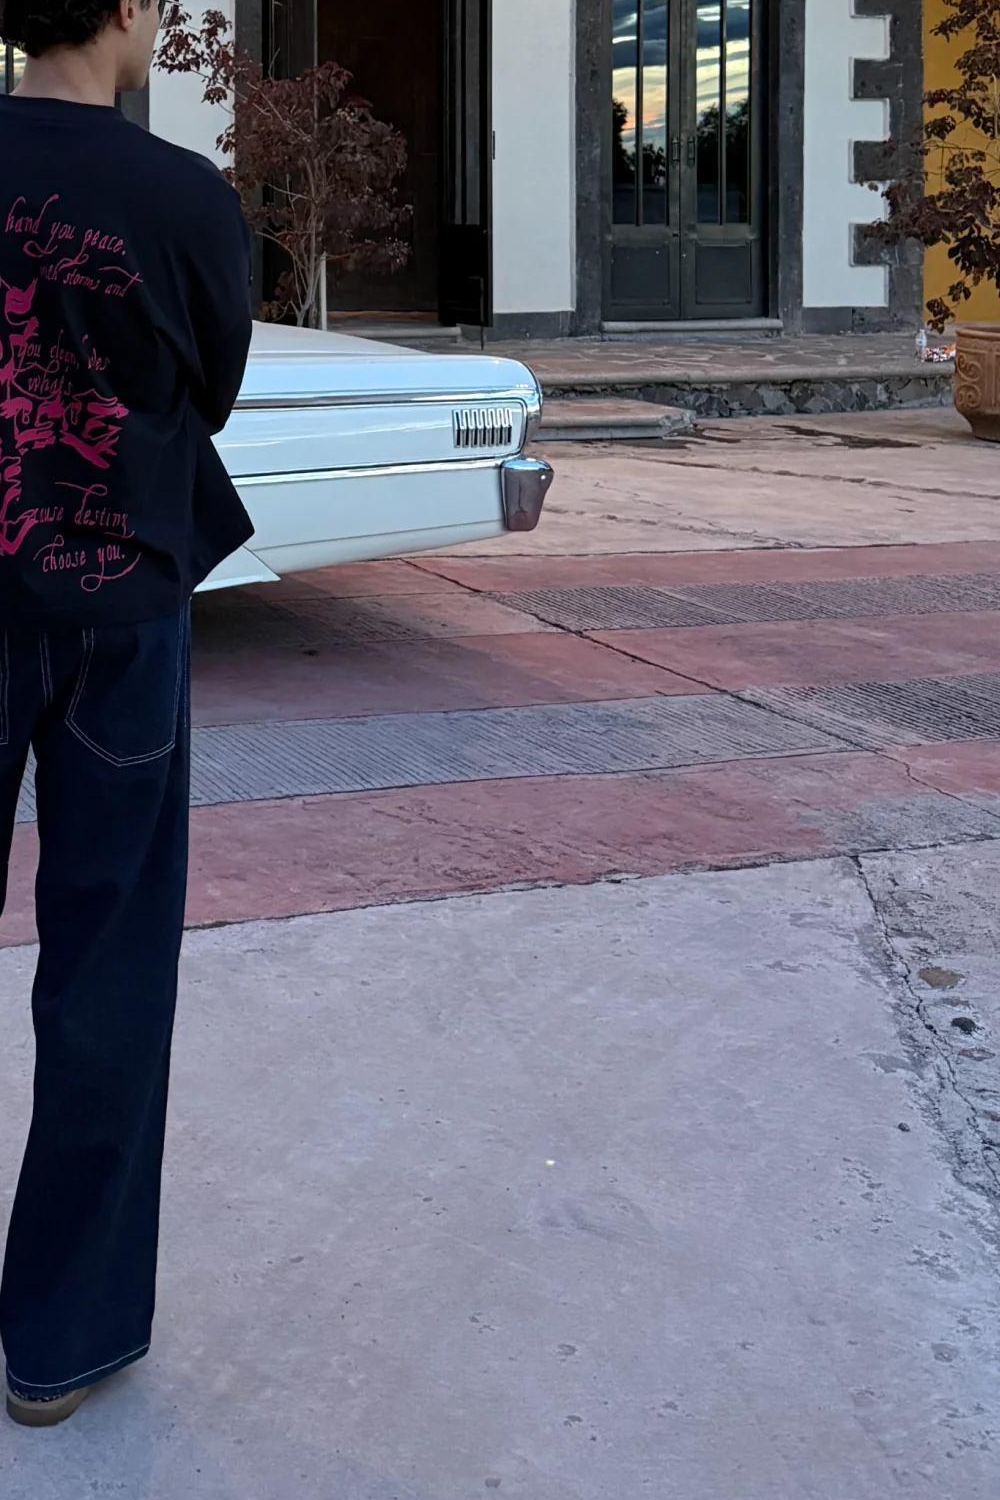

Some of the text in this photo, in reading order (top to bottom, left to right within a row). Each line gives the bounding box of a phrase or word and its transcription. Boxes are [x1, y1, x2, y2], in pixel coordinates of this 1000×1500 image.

[5, 193, 59, 235] hand
[23, 220, 76, 257] you
[62, 268, 101, 292] storms
[97, 266, 144, 298] and
[56, 481, 135, 539] destiny
[33, 534, 87, 573] choose
